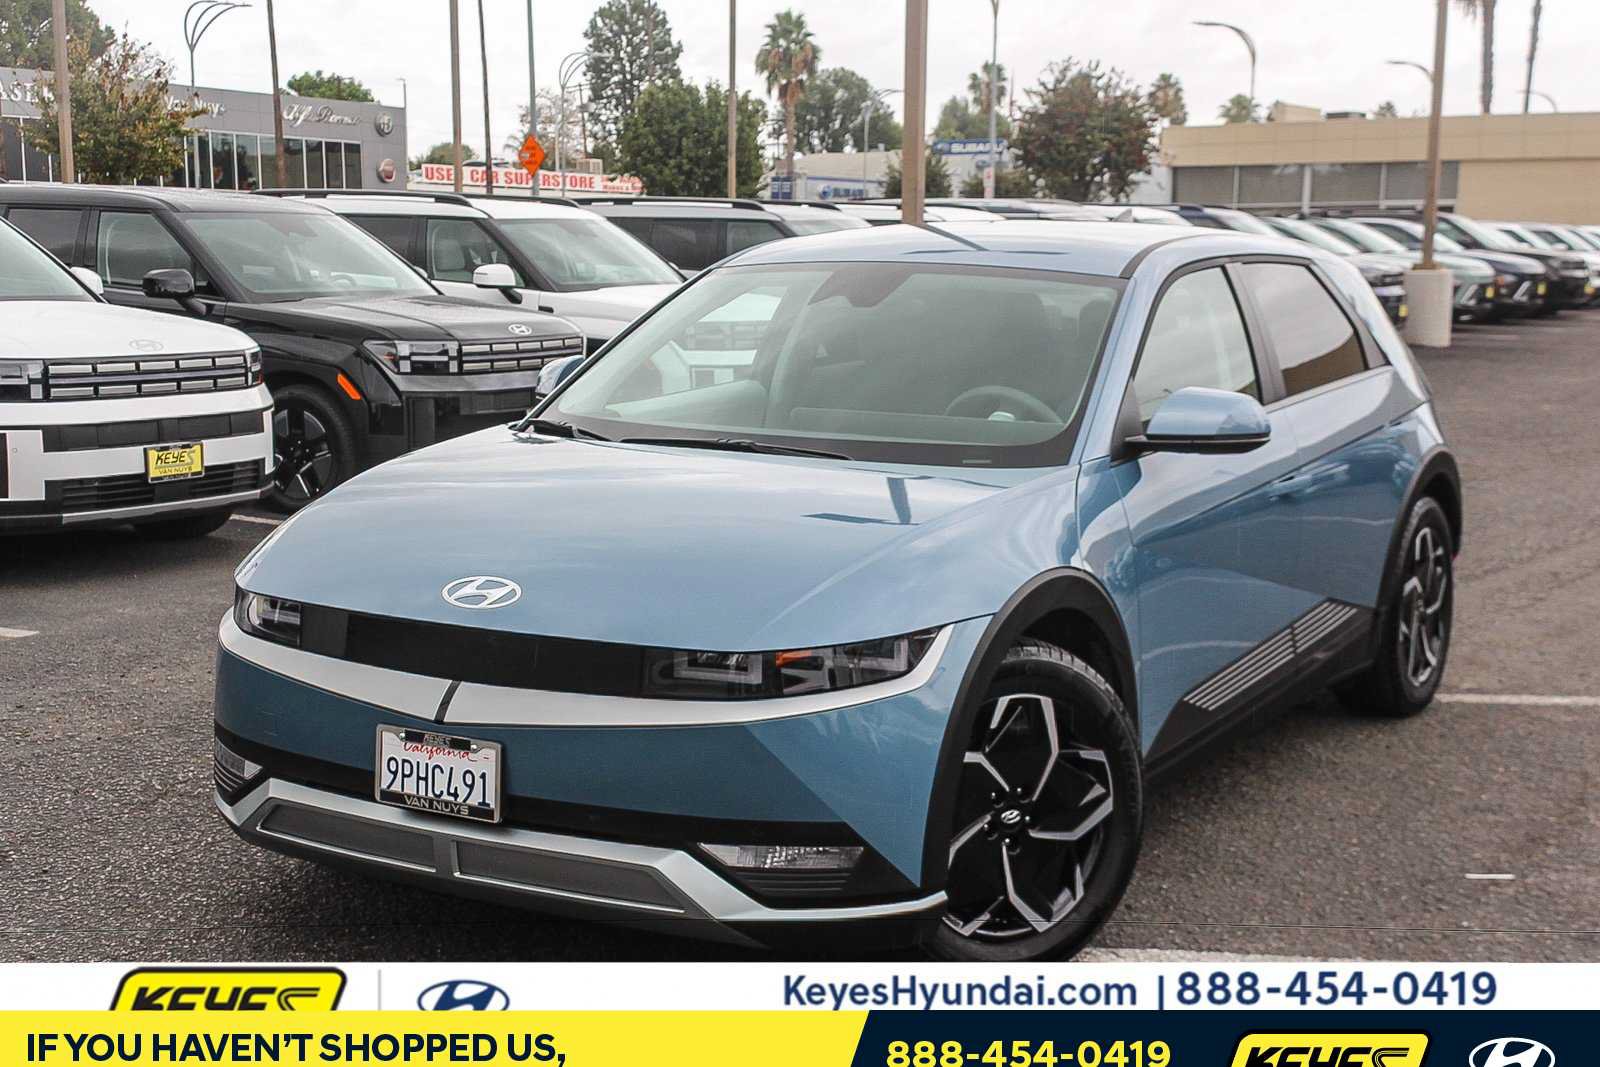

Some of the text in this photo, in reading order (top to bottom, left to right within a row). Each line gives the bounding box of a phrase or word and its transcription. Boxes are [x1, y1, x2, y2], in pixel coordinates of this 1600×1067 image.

[424, 166, 457, 181] USE
[155, 449, 196, 465] KEYES
[386, 756, 491, 809] 9PHC491
[404, 795, 470, 815] VAN NUYS
